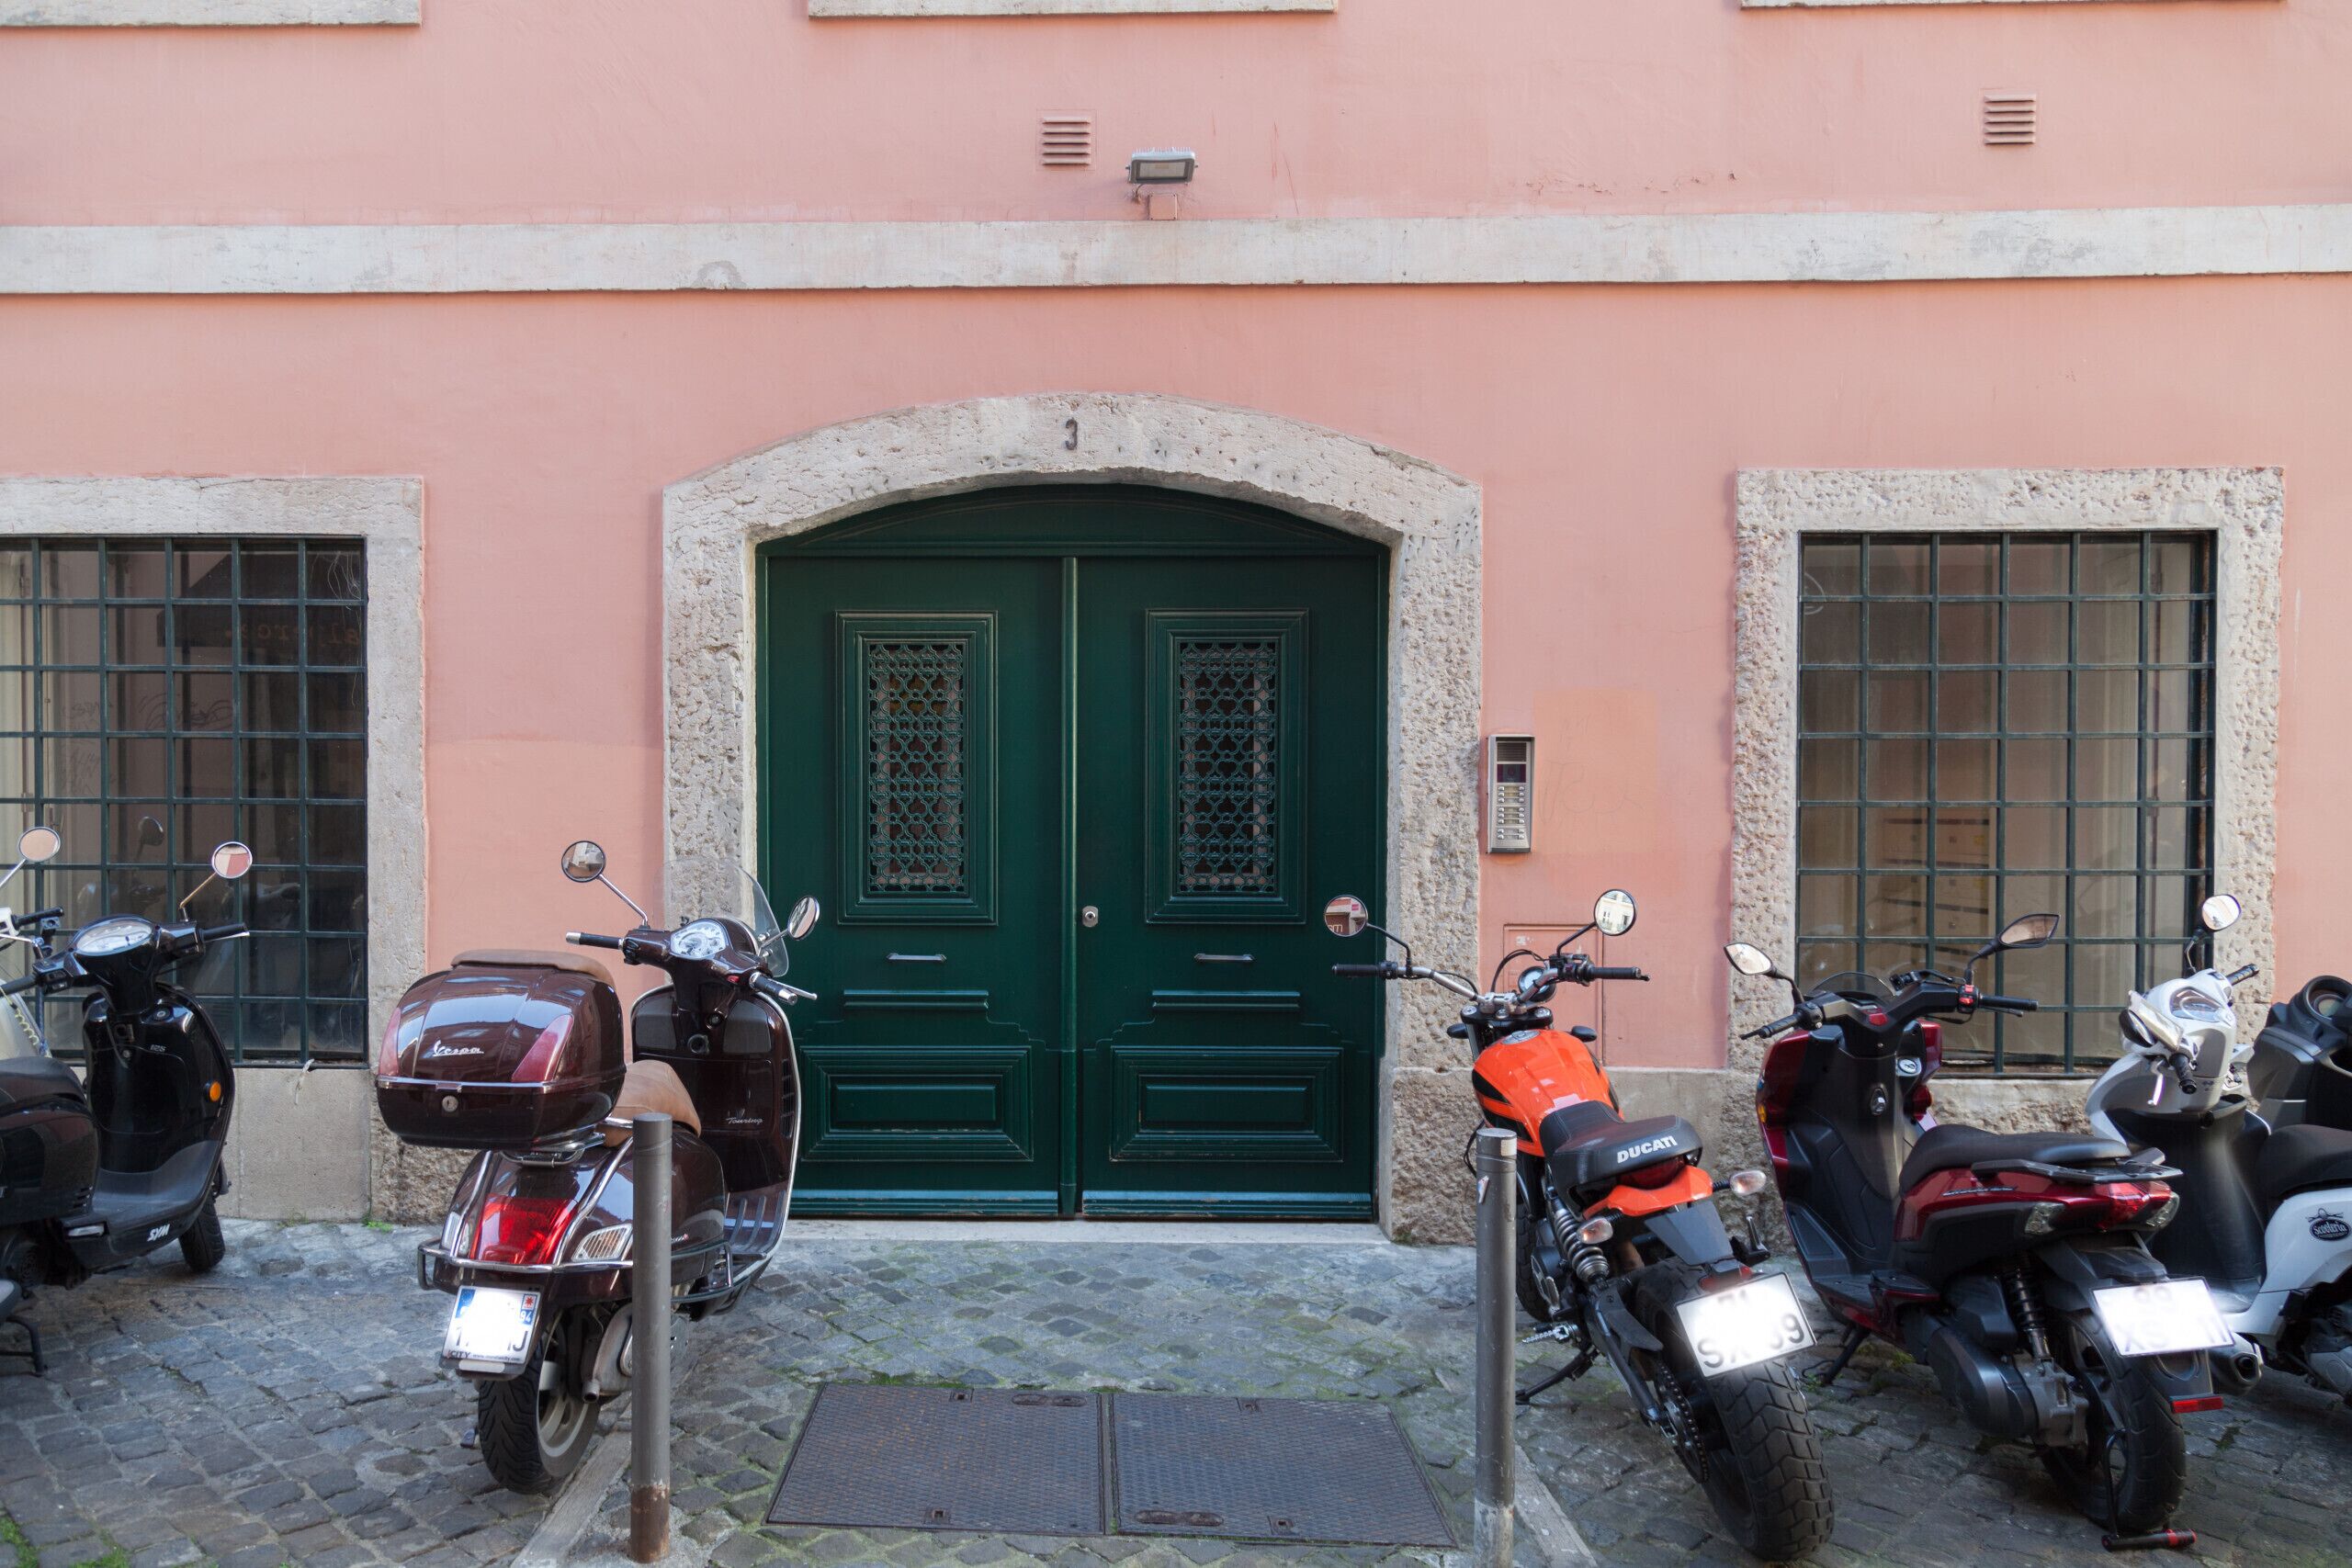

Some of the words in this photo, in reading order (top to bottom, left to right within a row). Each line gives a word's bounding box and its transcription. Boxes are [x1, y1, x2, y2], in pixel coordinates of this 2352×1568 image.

[1065, 418, 1078, 450] 3
[433, 1040, 484, 1056] Vespa
[726, 1117, 763, 1125] Touring
[1617, 1135, 1678, 1163] DUCATI
[147, 1224, 170, 1241] SYM
[520, 1310, 532, 1323] 94
